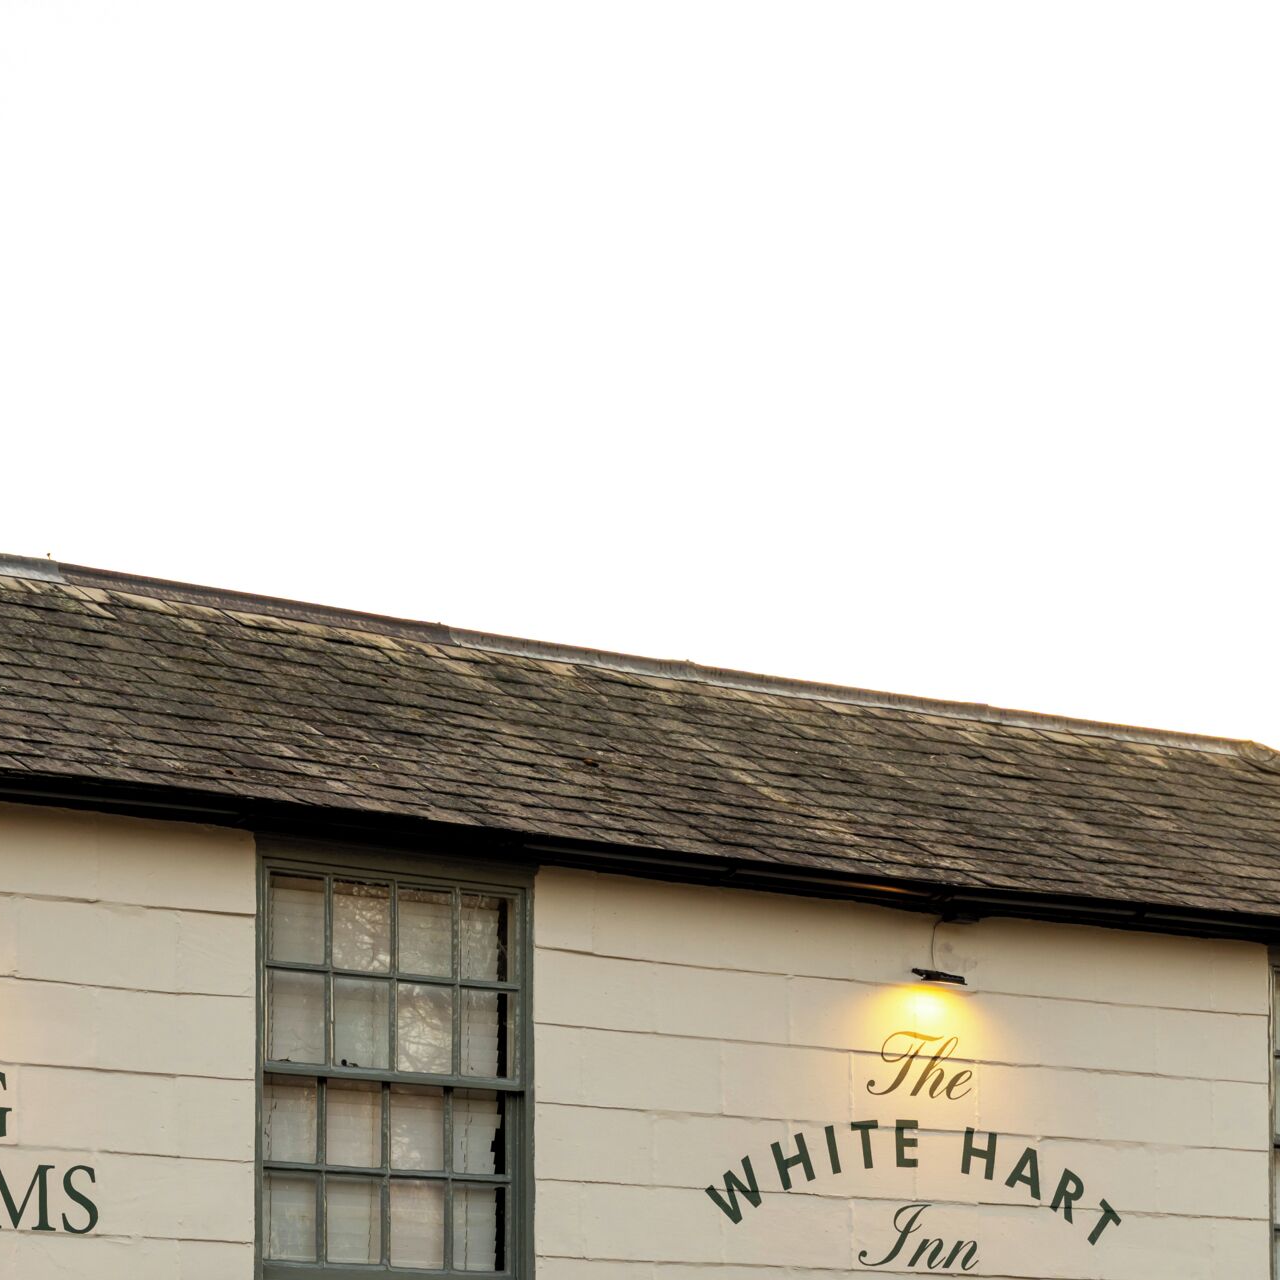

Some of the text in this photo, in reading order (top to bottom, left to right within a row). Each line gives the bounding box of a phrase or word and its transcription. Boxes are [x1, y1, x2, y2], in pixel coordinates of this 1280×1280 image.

[866, 1031, 973, 1100] The
[705, 1119, 1122, 1246] WHITE HART
[858, 1204, 979, 1271] Inn
